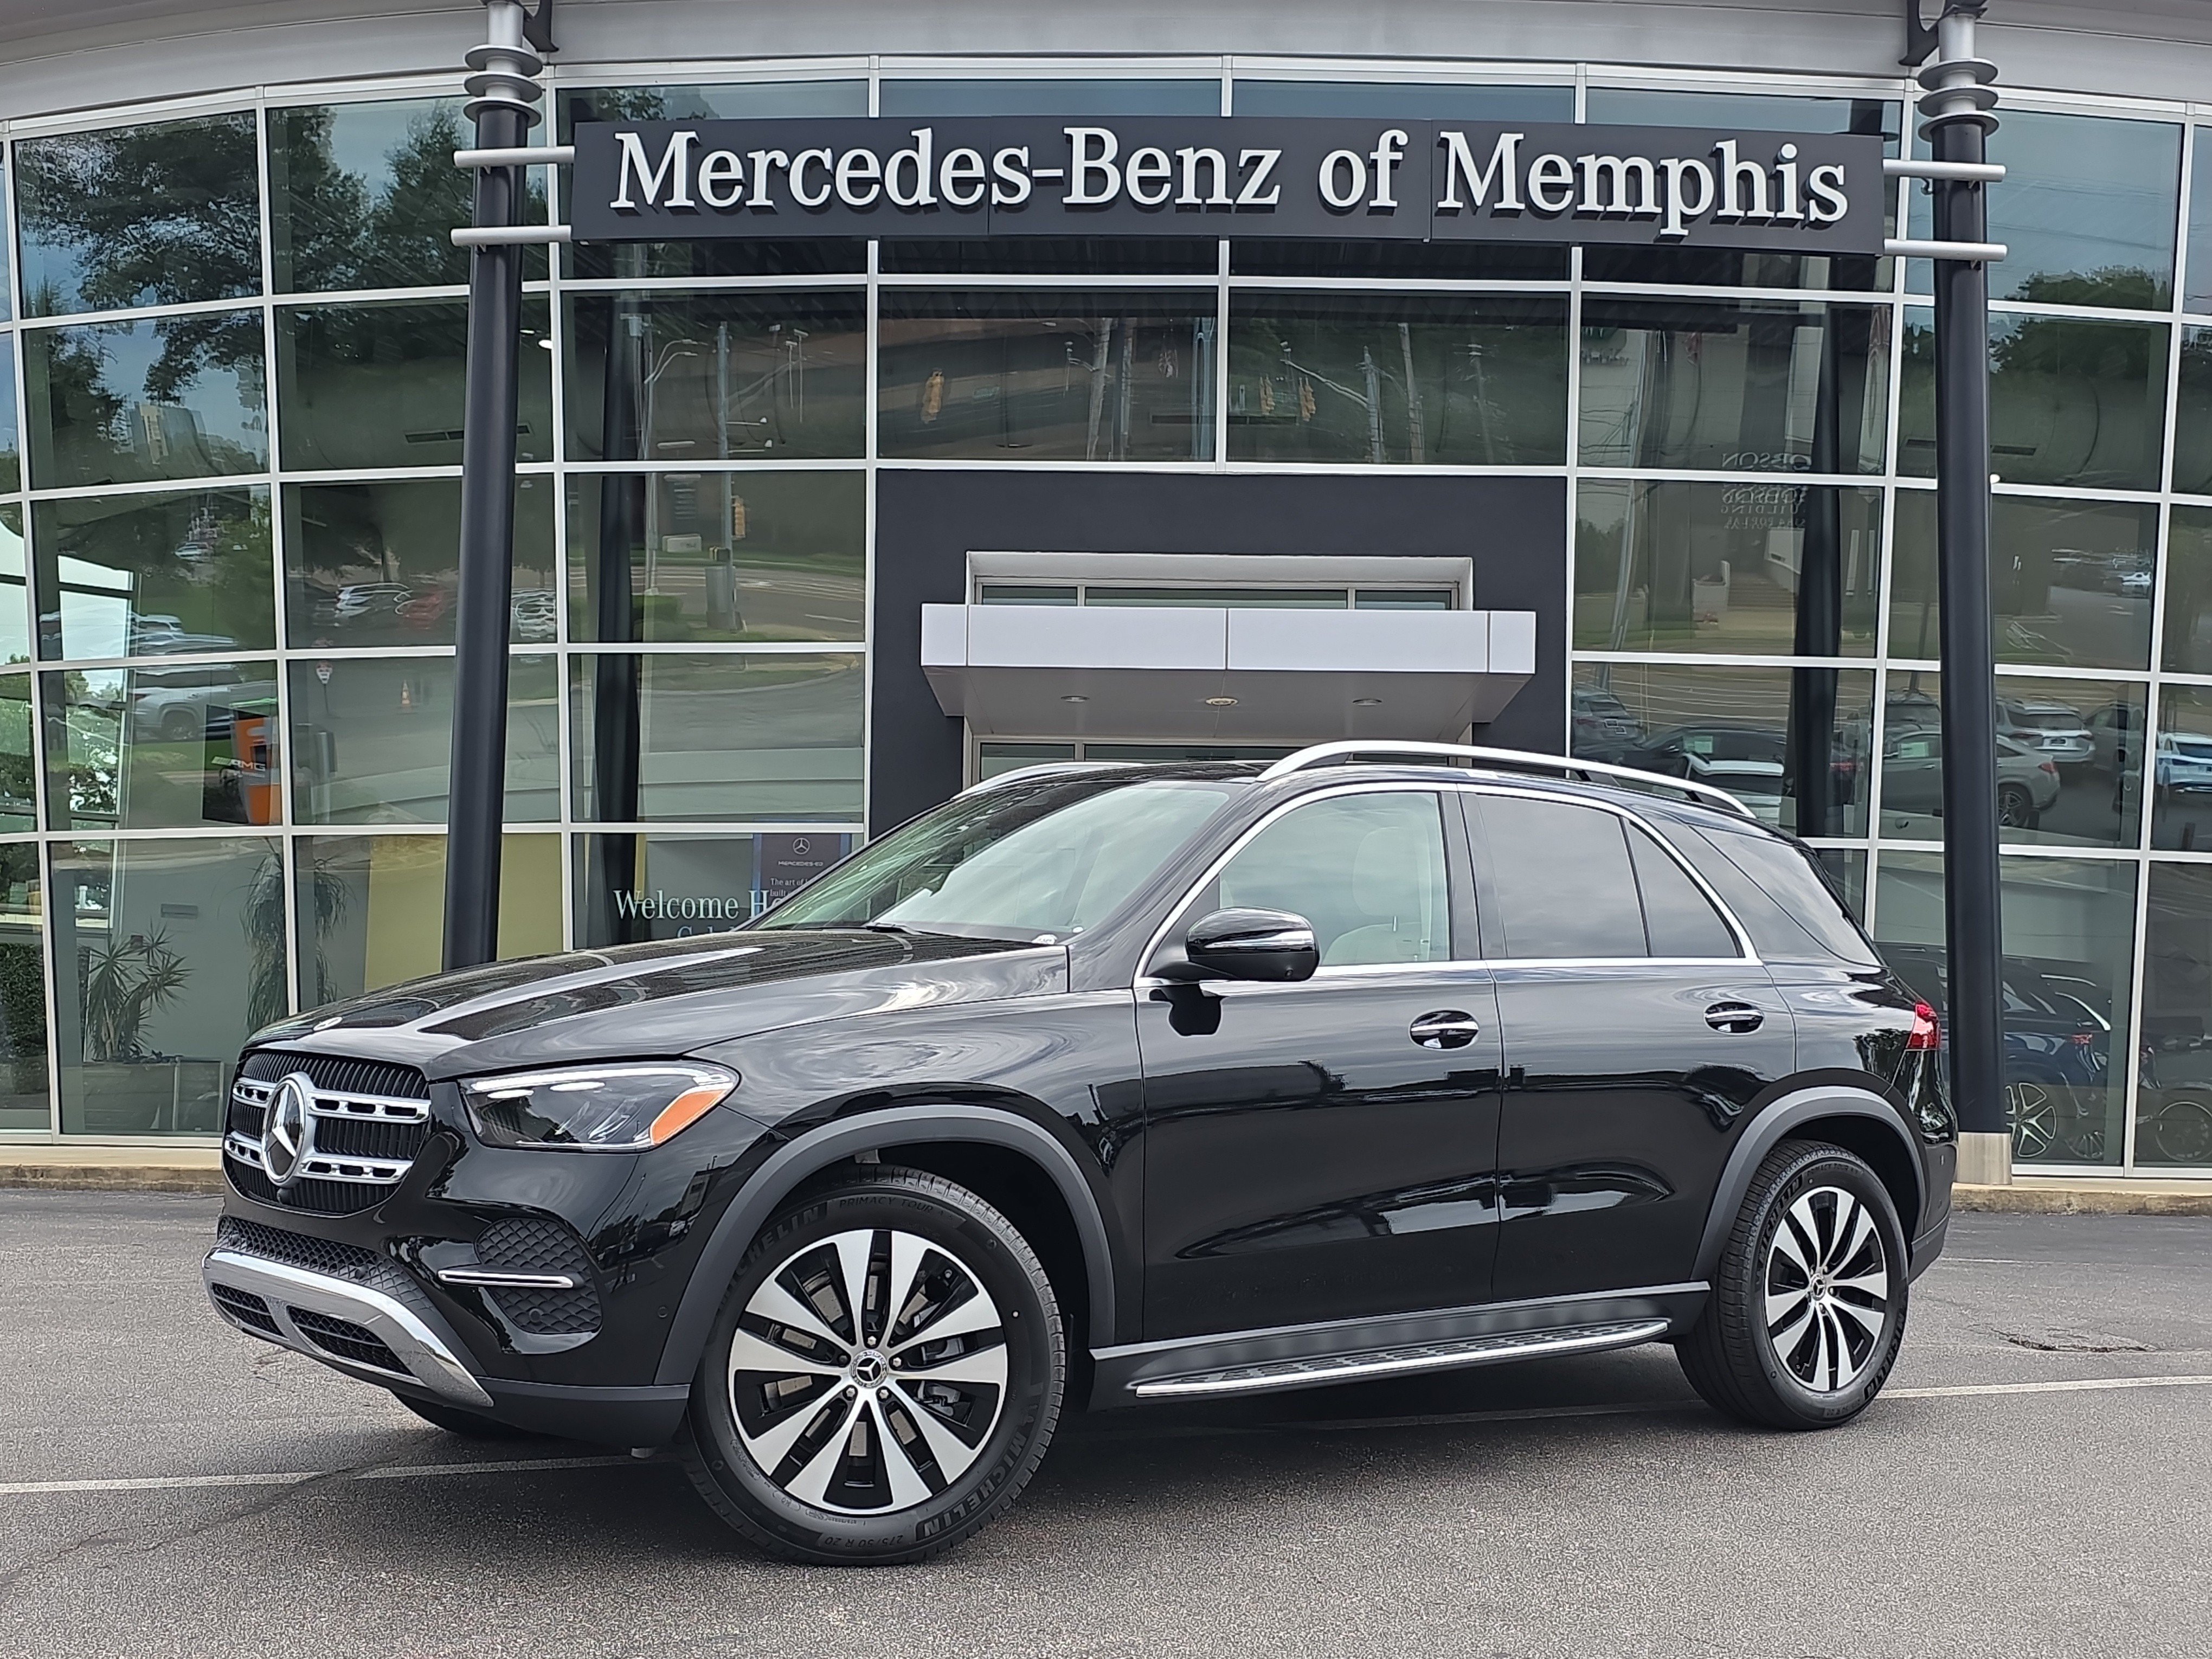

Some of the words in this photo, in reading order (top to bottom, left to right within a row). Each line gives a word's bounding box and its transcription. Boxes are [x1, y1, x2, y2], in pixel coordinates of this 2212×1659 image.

[610, 127, 1281, 209] Mercedes-Benz
[1319, 130, 1408, 208] of
[1437, 131, 1848, 236] Memphis
[231, 759, 266, 772] AMG
[613, 890, 739, 920] Welcome
[839, 1196, 896, 1208] PRIMACY
[901, 1199, 934, 1213] TOUR
[923, 1431, 1027, 1538] MICHELIN
[824, 1536, 843, 1547] 20
[844, 1538, 855, 1548] R
